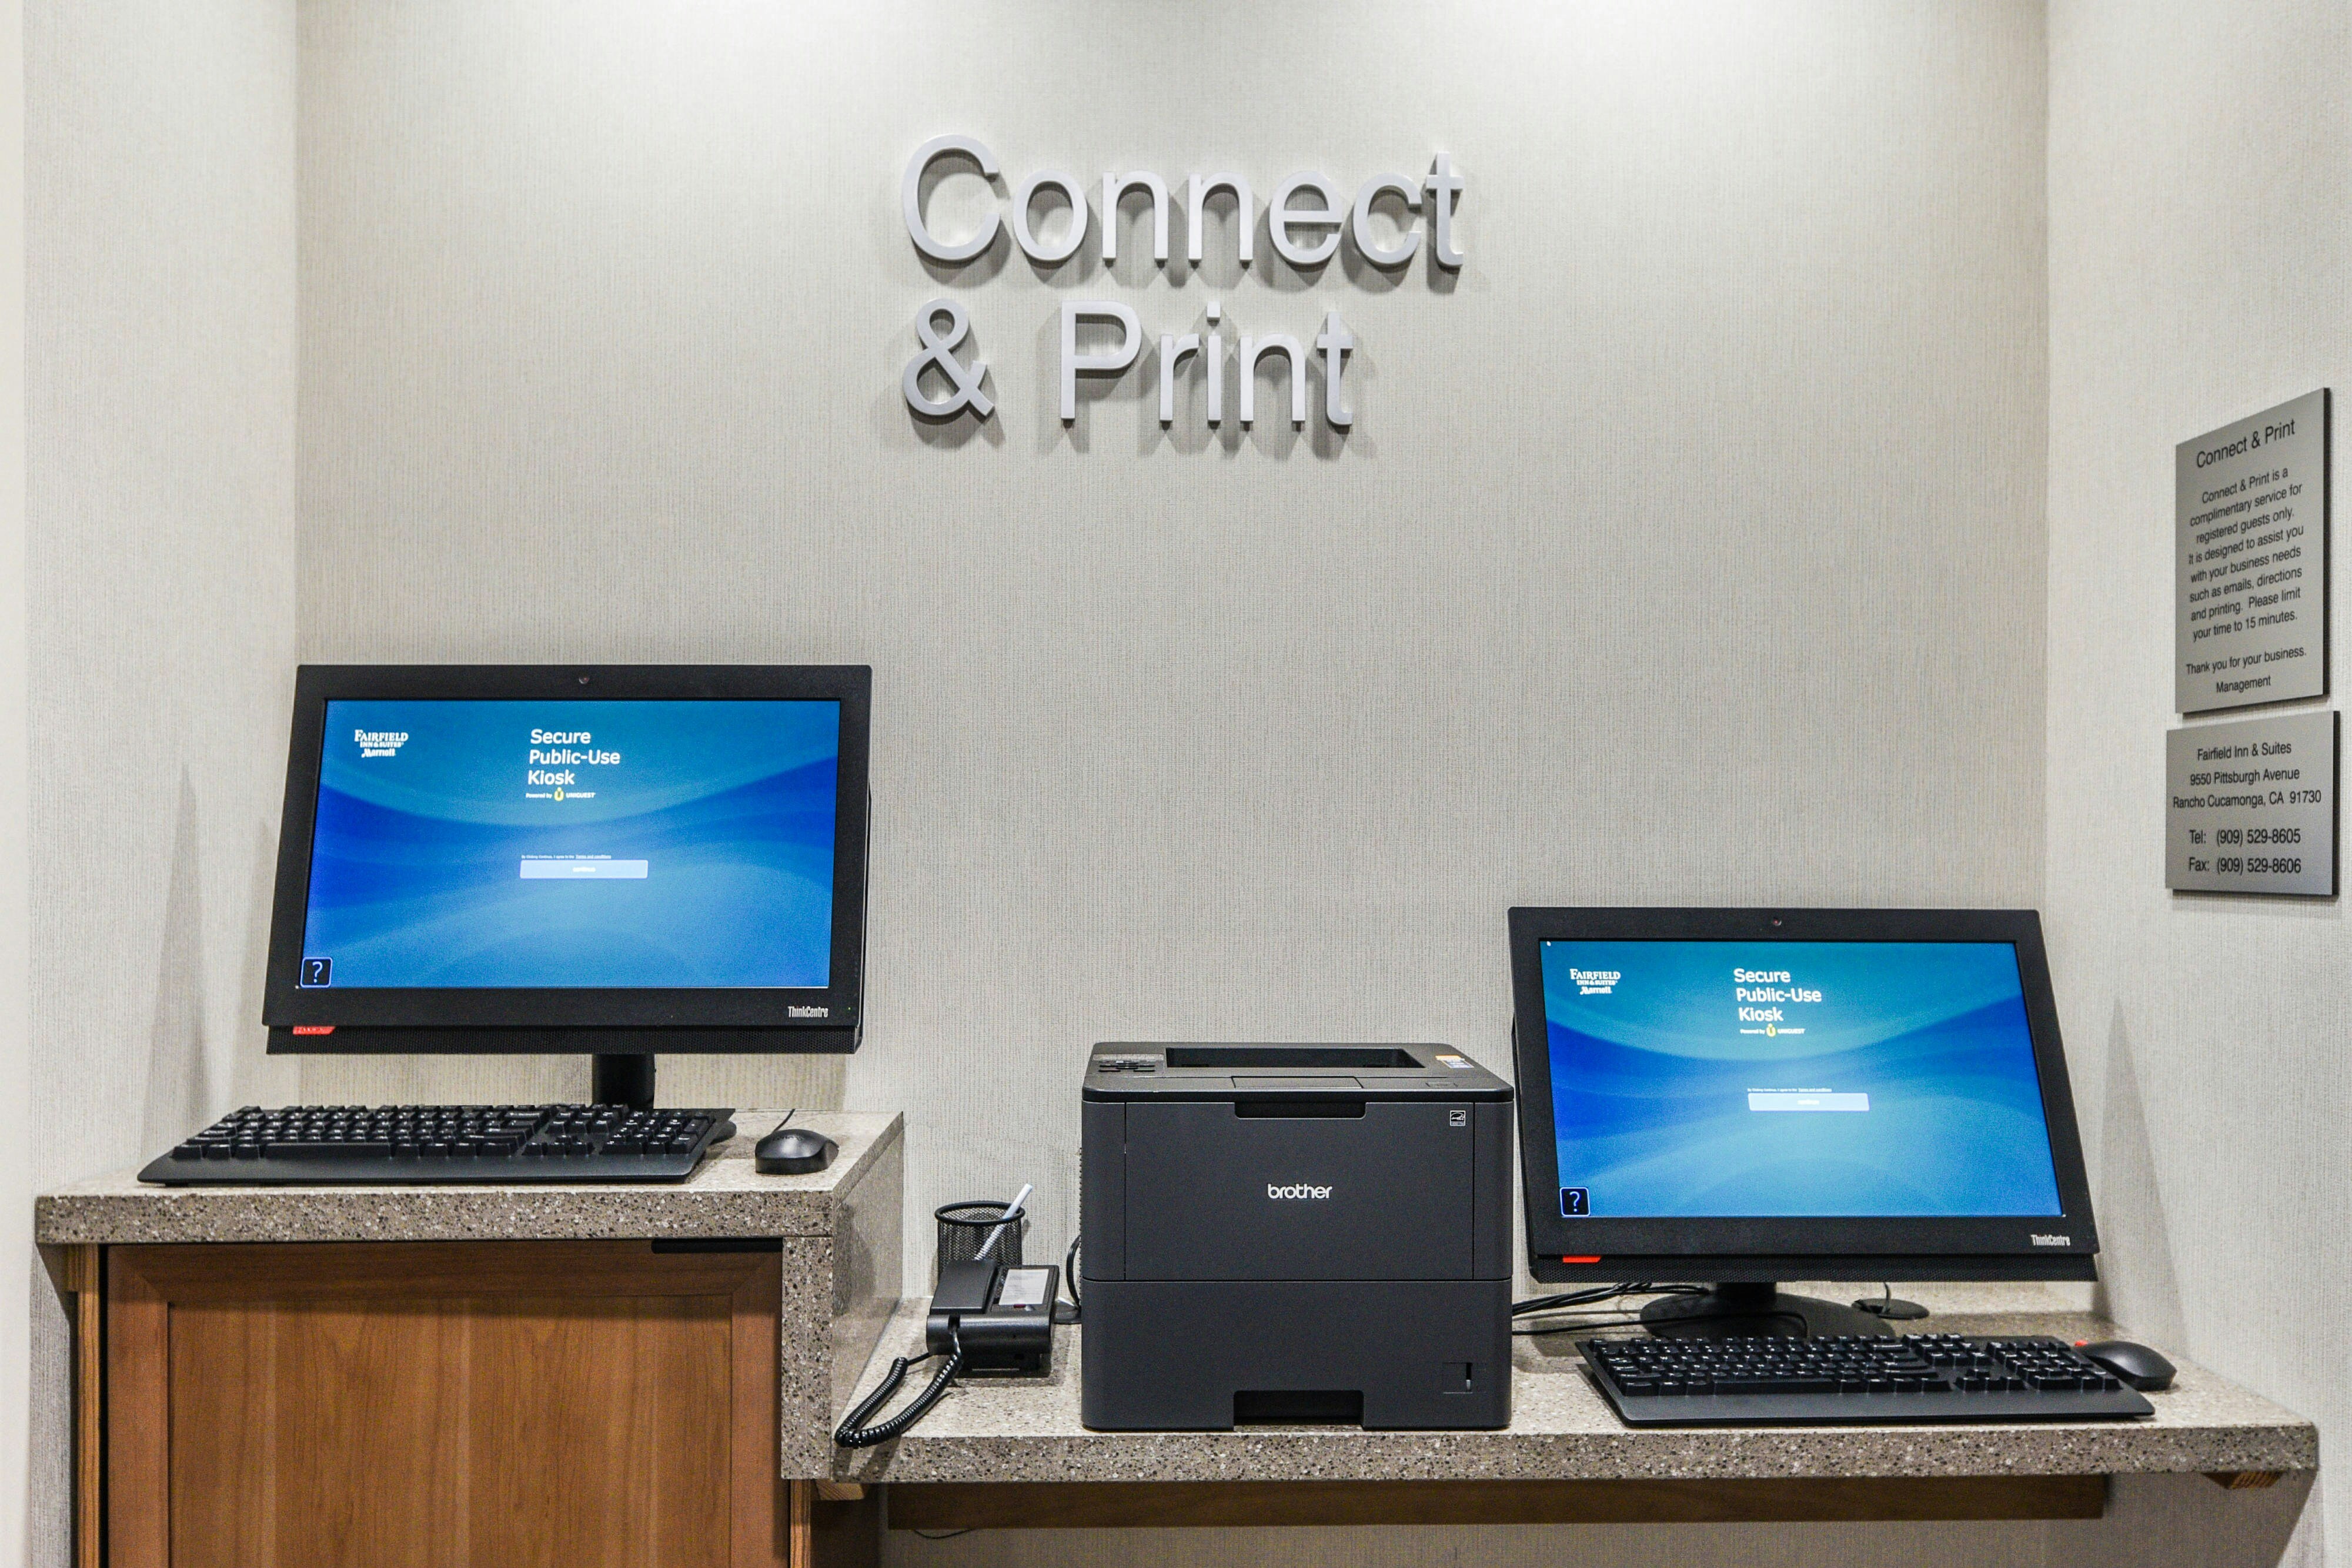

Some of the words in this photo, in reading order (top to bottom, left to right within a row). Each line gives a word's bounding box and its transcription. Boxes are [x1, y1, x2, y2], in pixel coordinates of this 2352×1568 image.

[901, 133, 1463, 269] Connect
[902, 297, 995, 418] &
[1060, 300, 1353, 427] Print
[2197, 436, 2247, 468] Connect
[2251, 431, 2260, 449] &
[2265, 419, 2295, 444] Print
[2202, 483, 2237, 504] Connect
[2240, 479, 2246, 492] &
[2249, 472, 2270, 489] Print
[2272, 469, 2280, 482] is
[2282, 468, 2288, 478] a
[2190, 500, 2252, 527] complimentary
[2254, 489, 2287, 507] service
[2290, 483, 2302, 497] for
[2196, 523, 2238, 544] registered
[2240, 514, 2270, 534] guests
[2273, 506, 2294, 522] only.
[2189, 553, 2194, 565] It
[2196, 551, 2202, 563] is
[2205, 540, 2244, 559] designed
[2246, 538, 2255, 549] to
[2257, 529, 2283, 547] assist
[2286, 526, 2304, 542] you
[2191, 570, 2207, 583] with
[2210, 566, 2228, 582] your
[2230, 554, 2269, 573] business
[2273, 545, 2301, 563] needs
[2190, 589, 2209, 603] such
[2212, 587, 2221, 597] as
[2224, 579, 2254, 595] emails,
[2257, 567, 2302, 587] directions
[2191, 607, 2206, 621] and
[2209, 601, 2243, 621] printing.
[2249, 594, 2279, 609] Please
[2281, 587, 2301, 602] limit
[2193, 627, 2211, 643] your
[2213, 623, 2231, 636] time
[2234, 620, 2243, 631] to
[2246, 616, 2256, 629] 15
[2259, 610, 2297, 627] minutes.
[2186, 661, 2210, 675] Thank
[2212, 660, 2227, 674] you
[2230, 656, 2240, 668] for
[2243, 654, 2261, 669] your
[2264, 646, 2306, 663] business.
[2216, 675, 2271, 693] Management
[530, 728, 591, 744] Secure
[529, 748, 620, 764] Public-Use
[2197, 746, 2232, 761] Fairfield
[2234, 745, 2249, 758] Inn
[2251, 743, 2259, 757] &
[2261, 741, 2292, 756] Suites
[528, 769, 575, 785] Kiosk
[2190, 773, 2211, 786] 9550
[2214, 769, 2260, 786] Pittsburgh
[2263, 768, 2300, 781] Avenue
[2173, 796, 2205, 808] Rancho
[2208, 794, 2266, 809] Cucamonga,
[2269, 791, 2284, 804] CA
[2290, 790, 2321, 804] 91730
[2189, 830, 2206, 844] Tel:
[2217, 828, 2243, 847] (909)
[2247, 828, 2301, 844] 529-8605
[2189, 857, 2210, 872] Fax:
[2217, 857, 2244, 875] (909)
[2247, 857, 2301, 874] 529-8606
[1733, 968, 1791, 983] Secure
[1736, 987, 1822, 1002] Public-Use
[788, 1006, 828, 1018] ThinkCentre
[1739, 1007, 1784, 1022] Kiosk
[1268, 1183, 1332, 1199] brother
[2030, 1234, 2070, 1246] ThinkCentre
